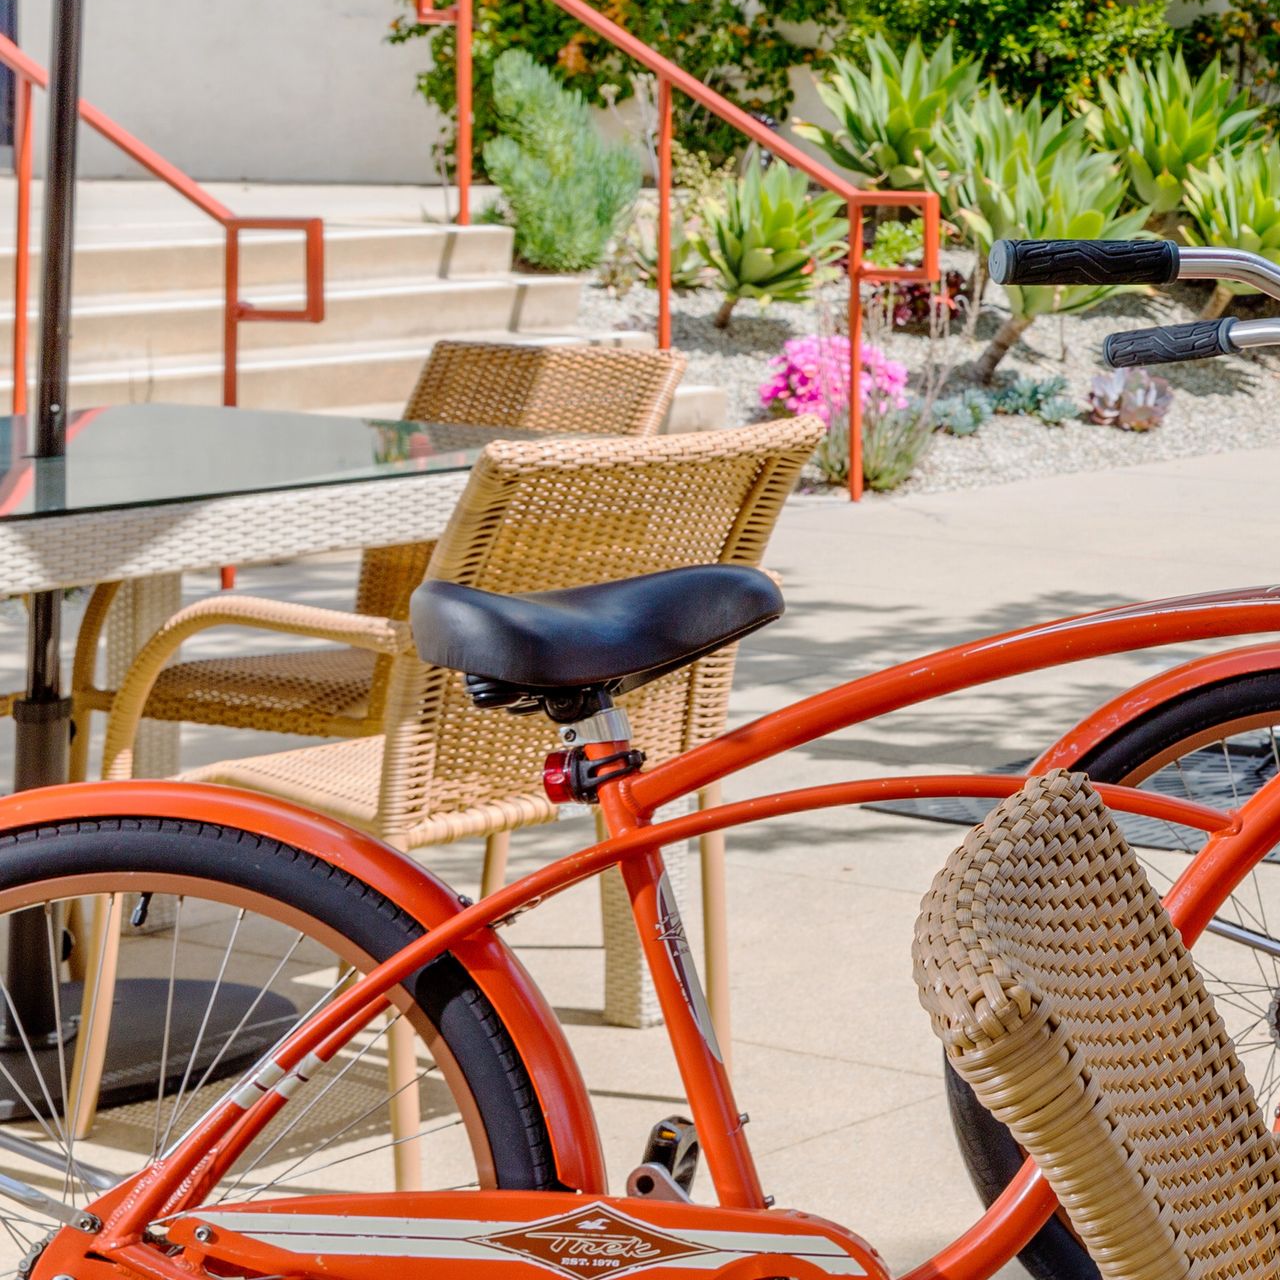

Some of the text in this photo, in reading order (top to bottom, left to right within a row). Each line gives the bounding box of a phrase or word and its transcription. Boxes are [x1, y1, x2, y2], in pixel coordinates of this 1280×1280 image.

[525, 1232, 661, 1258] Trek
[561, 1256, 620, 1268] EST. 1976
